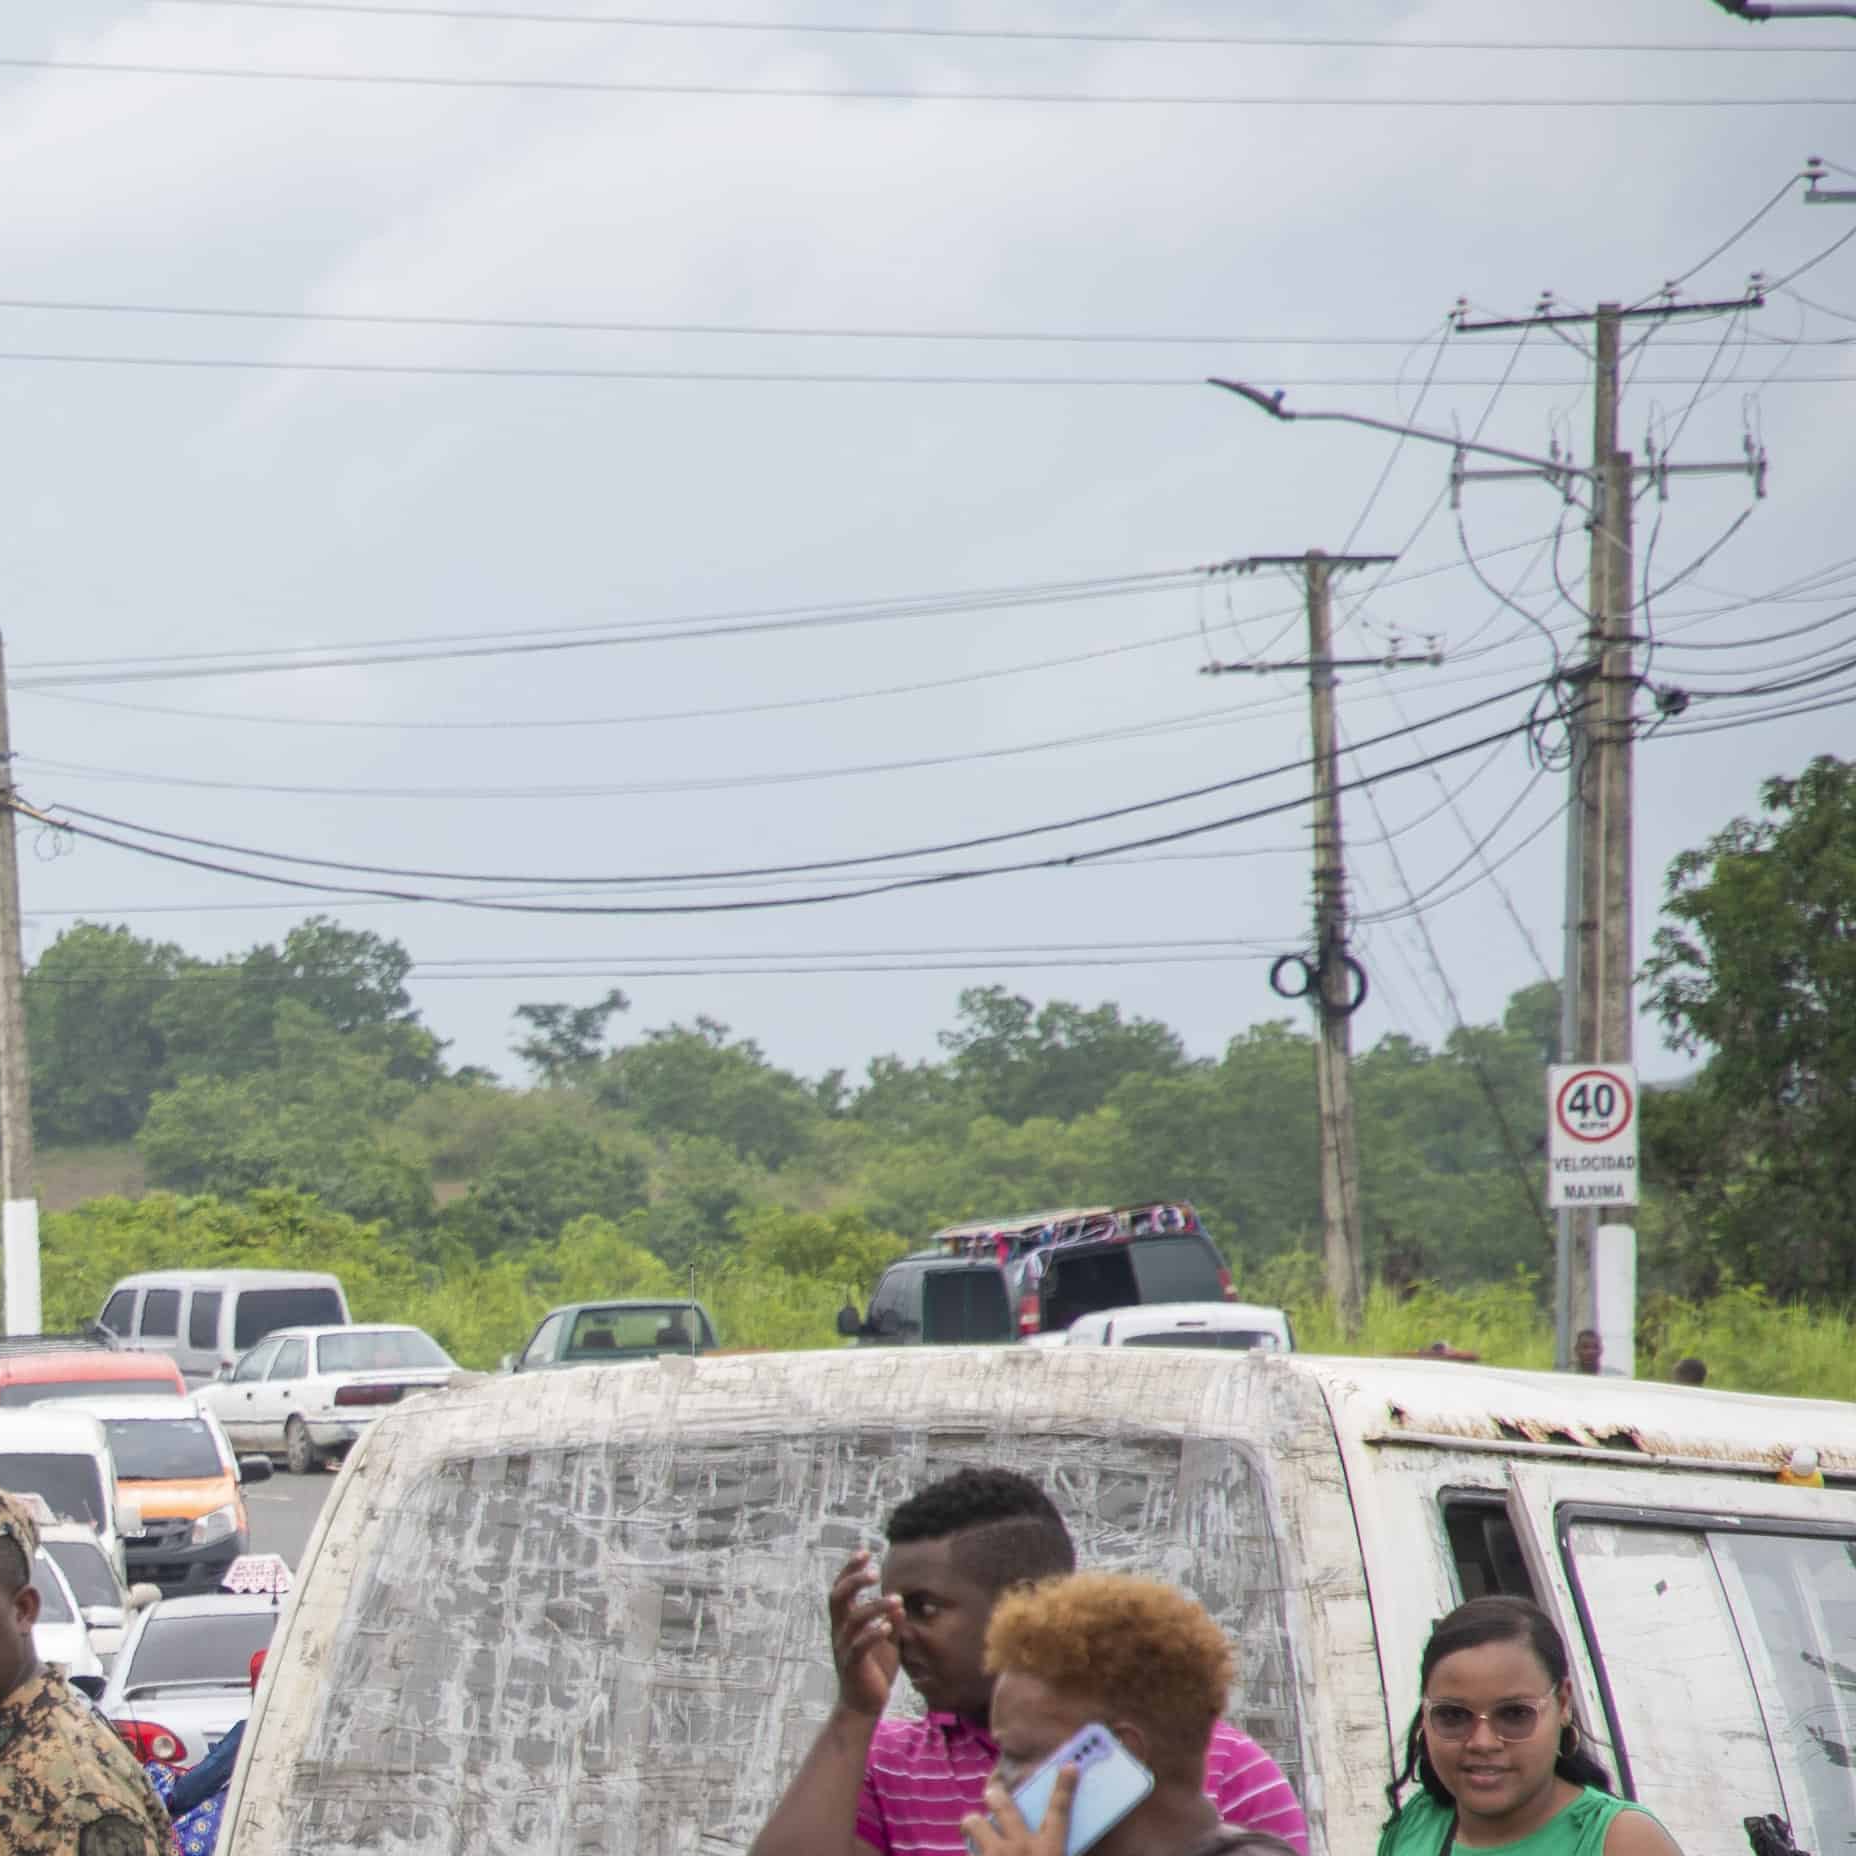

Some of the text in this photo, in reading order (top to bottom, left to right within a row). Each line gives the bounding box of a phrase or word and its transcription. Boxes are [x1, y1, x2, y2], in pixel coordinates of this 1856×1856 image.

[1568, 1084, 1616, 1119] 40
[1554, 1156, 1635, 1172] VELOCIDAD
[1564, 1184, 1625, 1199] MAXIMA
